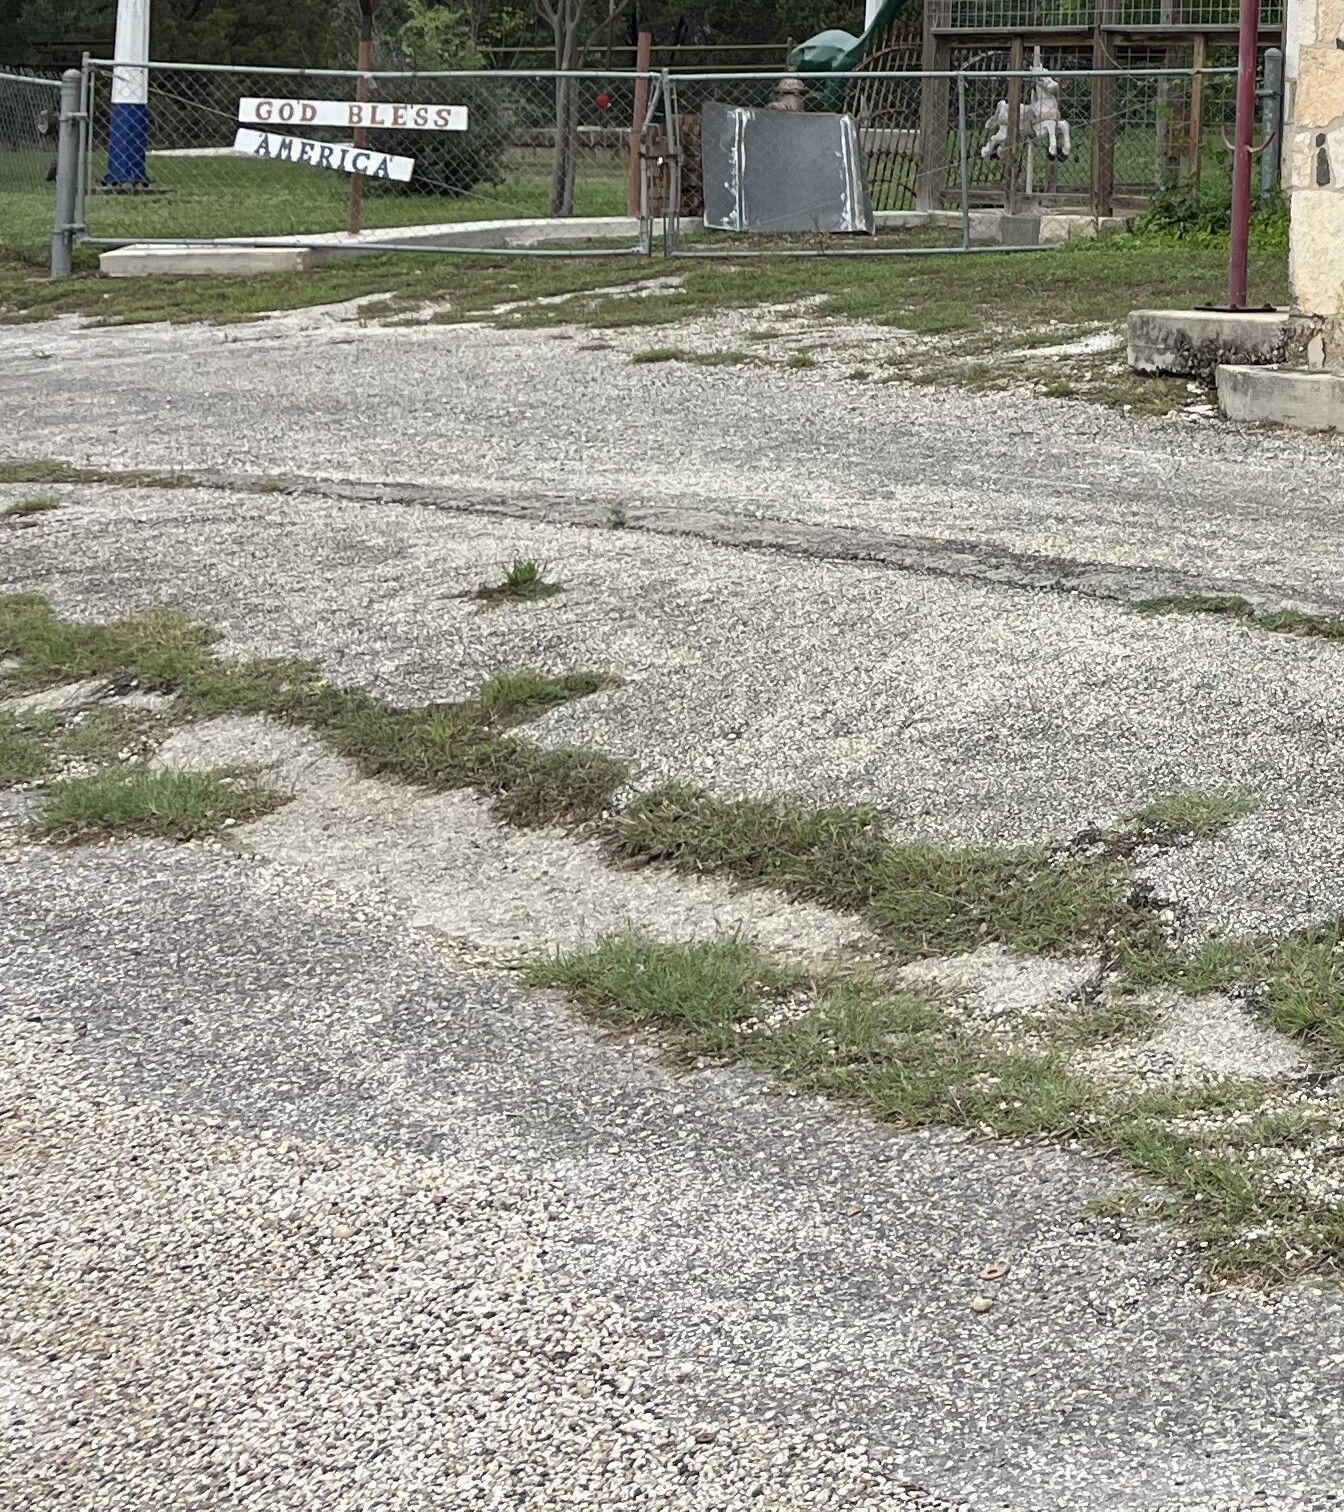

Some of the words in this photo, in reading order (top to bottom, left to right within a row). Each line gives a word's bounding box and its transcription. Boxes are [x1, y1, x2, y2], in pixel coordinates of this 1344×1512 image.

[254, 101, 318, 122] GOD
[348, 104, 452, 128] BLESS
[254, 133, 394, 179] AMERICA
